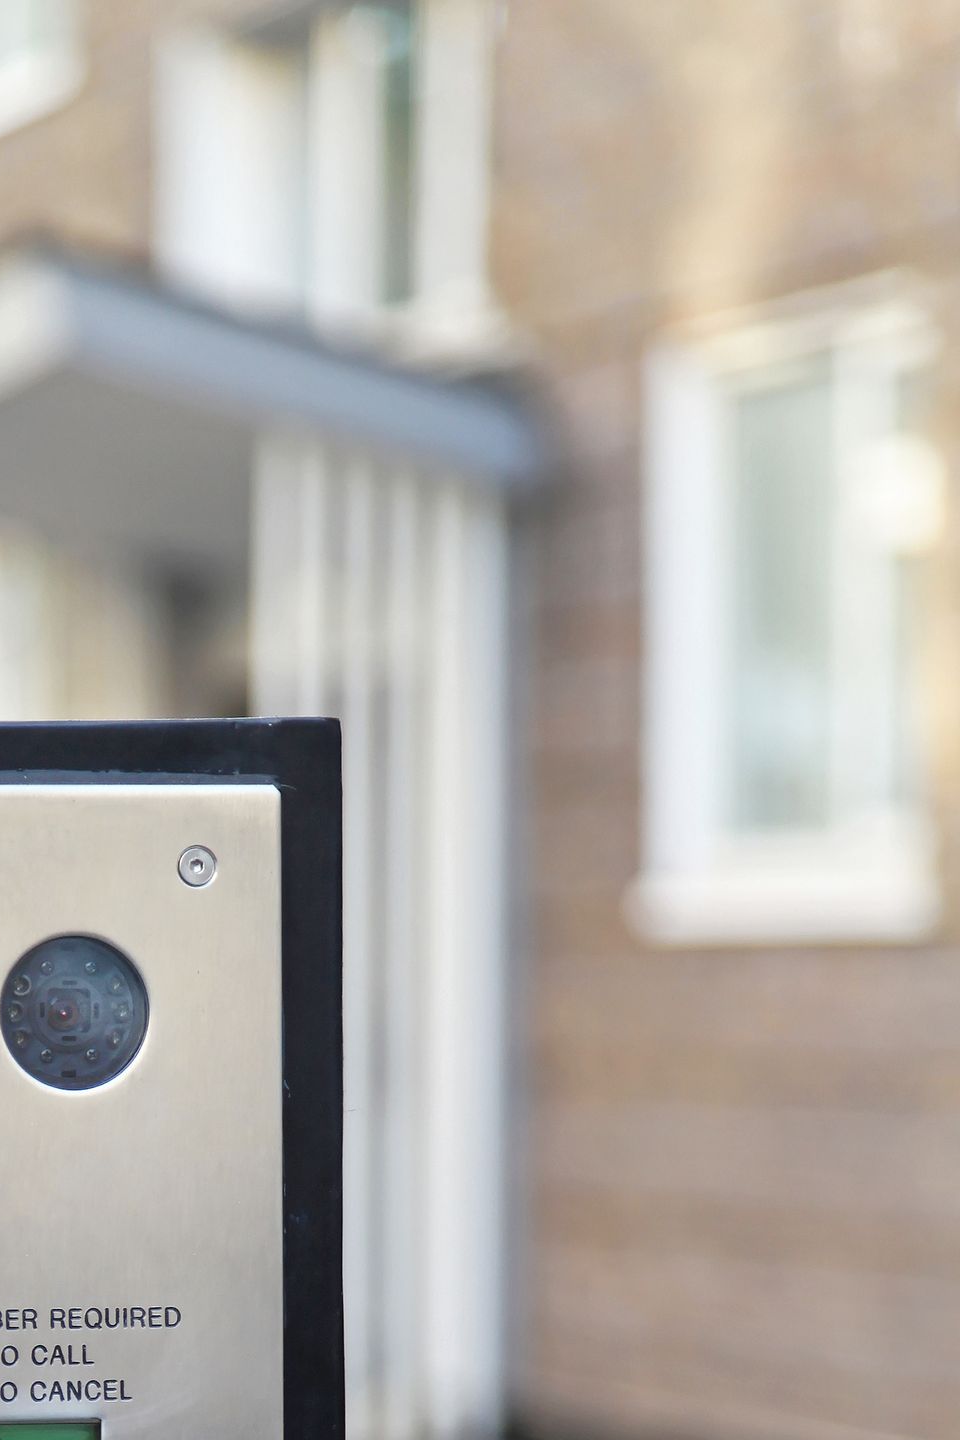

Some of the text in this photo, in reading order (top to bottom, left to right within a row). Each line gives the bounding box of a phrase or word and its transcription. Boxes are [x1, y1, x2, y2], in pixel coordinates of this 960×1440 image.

[50, 1306, 181, 1329] REQUIRED
[32, 1344, 94, 1365] CALL
[30, 1379, 133, 1401] CANCEL
